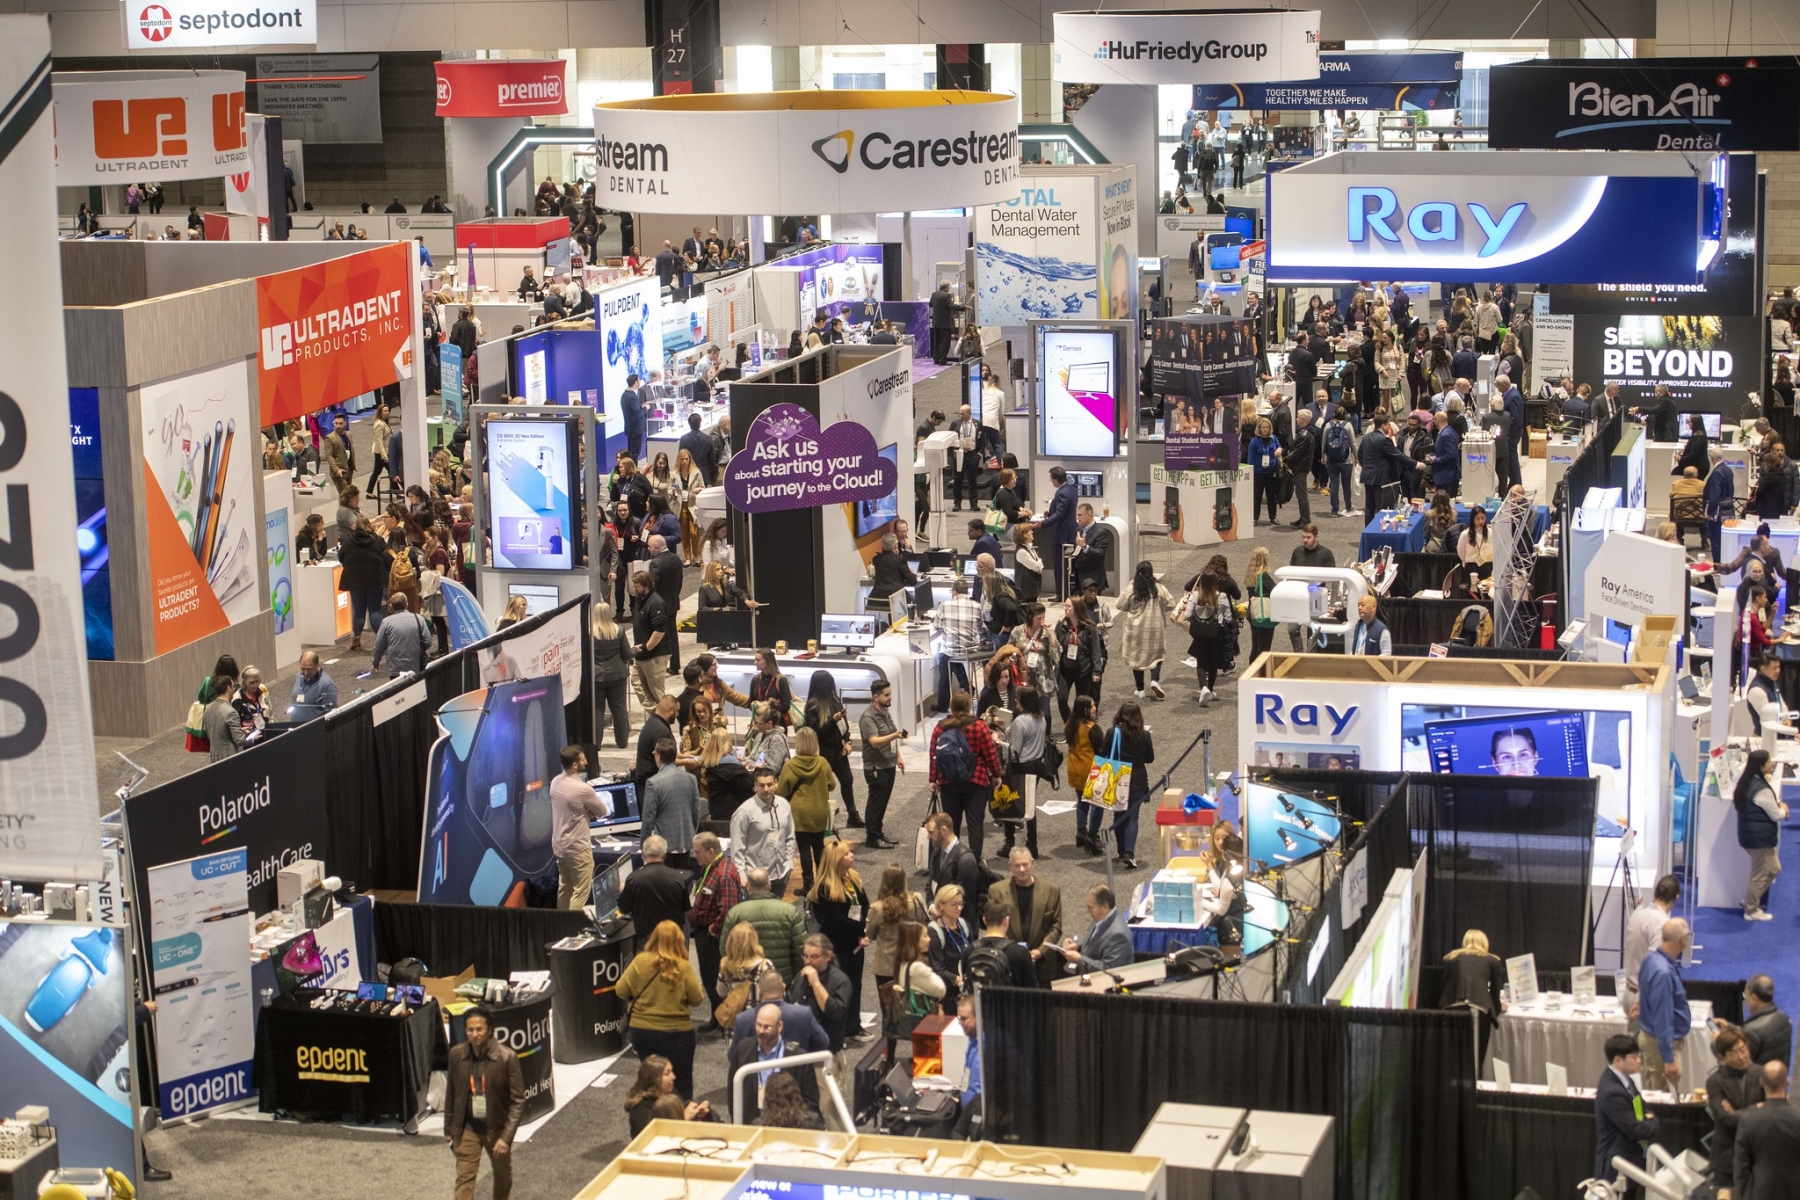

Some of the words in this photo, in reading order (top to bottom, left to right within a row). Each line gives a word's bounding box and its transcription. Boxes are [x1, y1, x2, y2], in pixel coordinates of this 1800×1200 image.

[179, 8, 303, 34] septodont
[670, 29, 682, 44] H
[667, 48, 686, 63] 27
[1108, 40, 1268, 63] HuFriedyGroup
[1265, 88, 1307, 97] TOGETHER
[1309, 88, 1323, 97] WE
[1324, 88, 1347, 97] MAKE
[1266, 96, 1303, 105] HEALTHY
[1304, 96, 1334, 105] SMILES
[1335, 96, 1368, 105] HAPPEN
[1656, 134, 1721, 150] Dental
[95, 159, 189, 172] ULTRADENT
[610, 175, 669, 196] DENTAL
[991, 209, 1034, 222] Dental
[1037, 210, 1078, 222] Water
[1347, 186, 1528, 258] Ray
[991, 223, 1080, 239] Management
[1598, 283, 1616, 292] The
[1619, 283, 1652, 293] shield
[1655, 285, 1675, 294] you
[1677, 284, 1708, 293] need.
[294, 289, 401, 344] ULTRADENT
[603, 293, 641, 319] PULPDENT
[295, 329, 371, 363] PRODUCTS,
[379, 316, 403, 336] INC.
[1603, 326, 1644, 346] SEE
[1603, 348, 1733, 378] BEYOND
[873, 370, 910, 397] Carestream
[752, 440, 790, 462] Ask
[795, 441, 818, 456] us
[1166, 436, 1181, 444] Dental
[1200, 437, 1223, 446] Reception
[734, 470, 760, 480] about
[761, 460, 823, 477] starting
[827, 454, 863, 475] your
[1154, 468, 1164, 480] GET
[1177, 471, 1190, 485] APP
[1200, 473, 1213, 487] GET
[1214, 470, 1228, 485] THE
[1229, 470, 1244, 483] APP
[746, 481, 806, 504] journey
[817, 484, 831, 492] the
[832, 470, 883, 491] Cloud!
[158, 585, 199, 609] ULTRADENT
[1601, 577, 1622, 595] Ray
[1622, 584, 1654, 605] America
[159, 598, 200, 623] PRODUCTS?
[1601, 592, 1615, 605] Face
[1614, 596, 1630, 609] Driven
[1629, 601, 1653, 616] Dentistry
[543, 644, 560, 670] pain
[1254, 693, 1359, 737] Ray
[199, 776, 271, 835] Polaroid
[200, 867, 214, 876] UC
[431, 831, 448, 894] AI
[98, 881, 115, 924] NEW
[158, 952, 172, 963] UC
[297, 1045, 369, 1073] epdent
[170, 1069, 248, 1114] epdent
